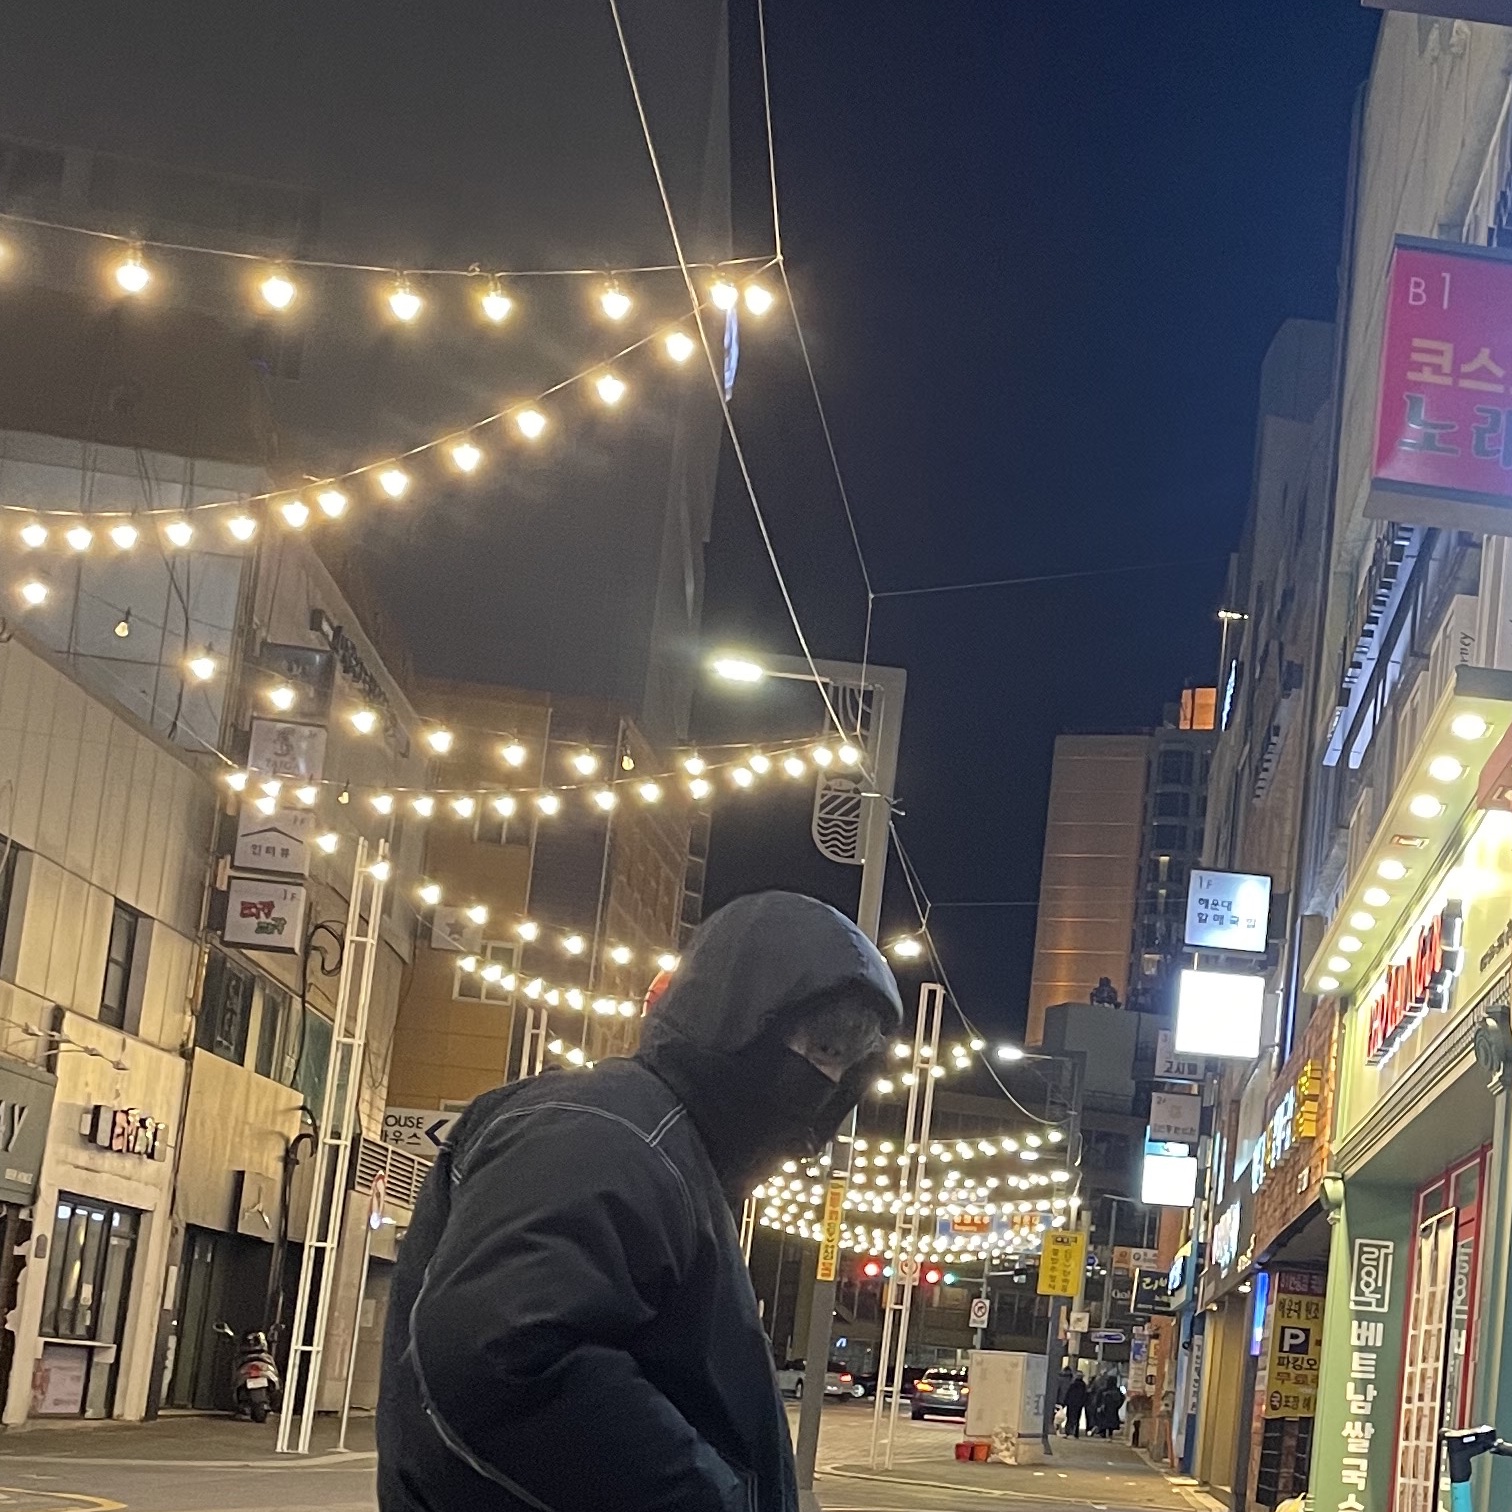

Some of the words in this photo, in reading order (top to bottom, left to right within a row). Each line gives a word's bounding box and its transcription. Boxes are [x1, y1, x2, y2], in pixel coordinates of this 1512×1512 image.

[251, 844, 290, 858] 인터뷰
[384, 1114, 425, 1130] OUSE
[1282, 1328, 1306, 1352] P
